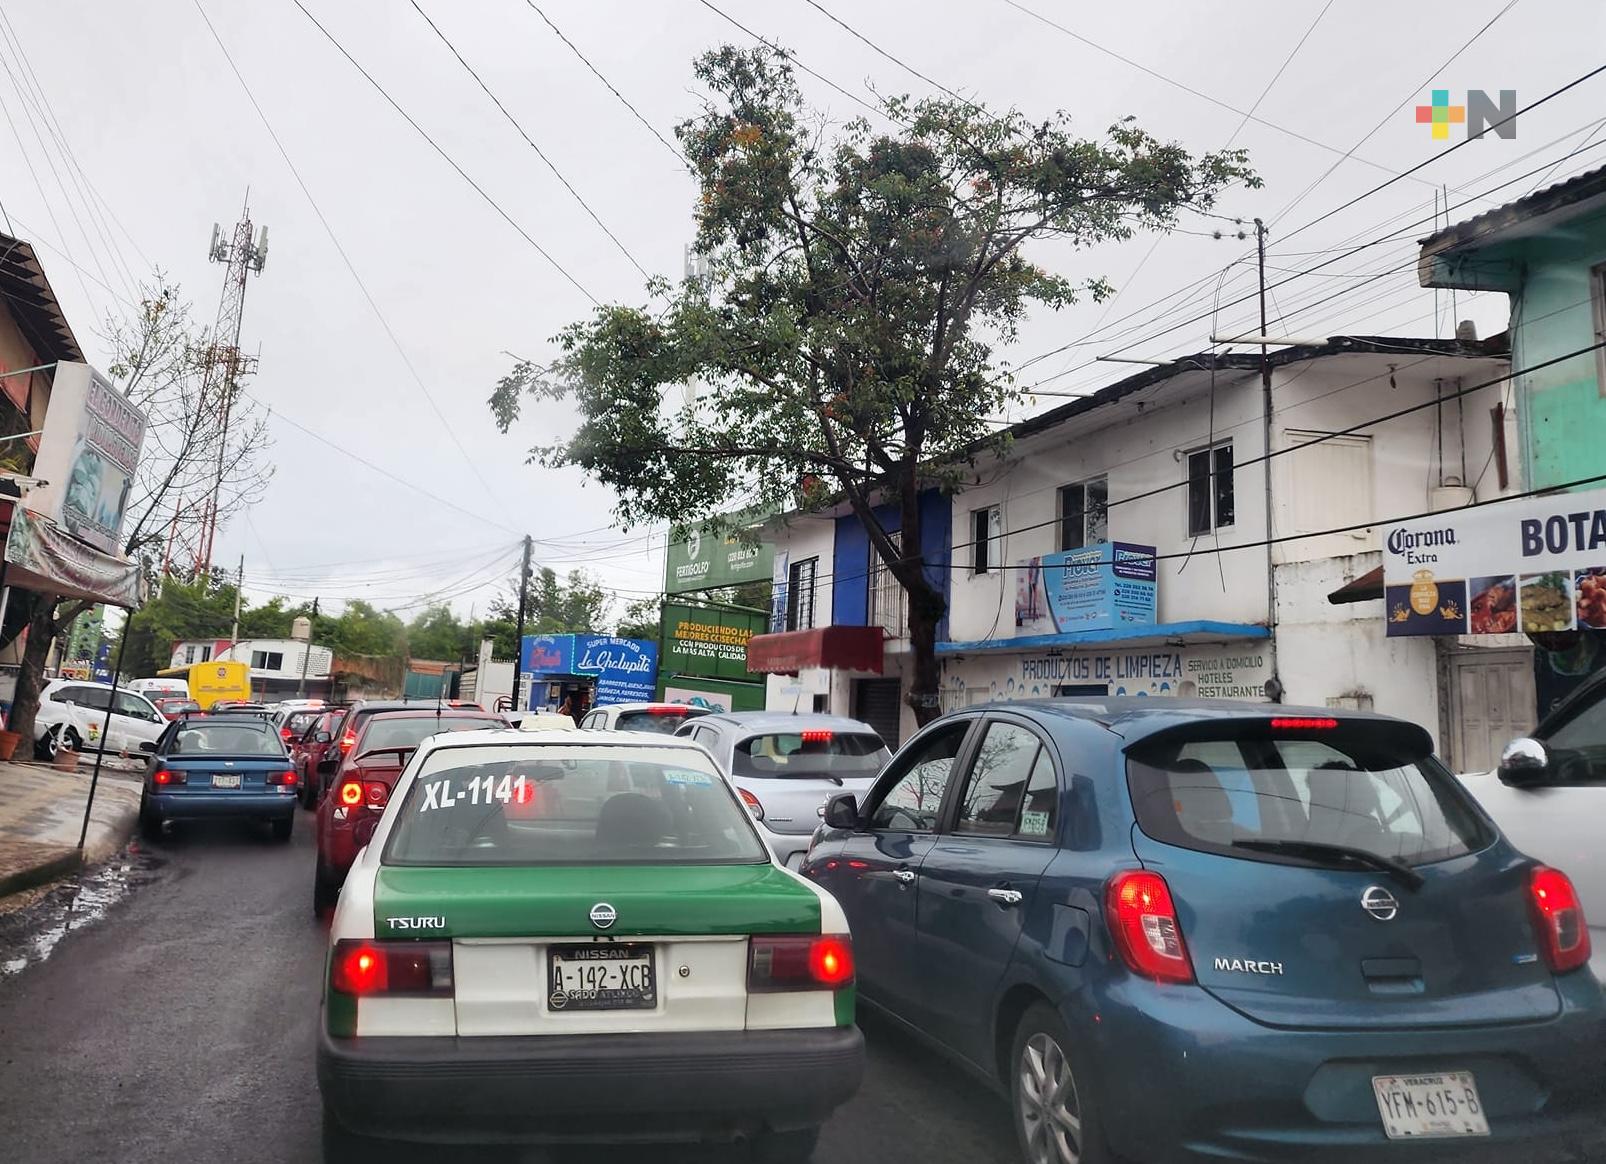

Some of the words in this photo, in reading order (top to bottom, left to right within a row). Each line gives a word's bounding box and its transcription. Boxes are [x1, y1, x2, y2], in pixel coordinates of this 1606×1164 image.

[1387, 528, 1457, 556] Corona
[1407, 551, 1438, 565] Extra
[676, 560, 709, 577] FERTIGOLFO
[678, 621, 738, 636] PRODUCIENDO
[586, 638, 608, 648] SUPER
[609, 638, 640, 653] MERCADO
[675, 630, 708, 640] MEJORES
[710, 634, 751, 645] COSECHA
[672, 645, 682, 654] LA
[697, 648, 716, 657] ALTA
[718, 651, 747, 661] CALIDAD
[679, 639, 694, 648] CON
[694, 641, 736, 652] PRODUCTOS
[735, 645, 745, 653] DE
[596, 650, 651, 674] Chalupita
[1022, 656, 1089, 680] PRODUCTOS
[1095, 656, 1111, 679] DE
[1117, 654, 1183, 679] LIMPIEZA
[1188, 660, 1218, 672] SERVICIO
[1219, 659, 1225, 670] A
[1226, 656, 1263, 669] DOMICILIO
[1198, 673, 1233, 684] HOTELES
[420, 774, 526, 812] XL-1141
[387, 916, 445, 929] TSURU
[575, 950, 629, 959] NISSAN
[1214, 957, 1285, 975] MARCH
[554, 964, 651, 991] A-142-XCB
[1402, 1078, 1444, 1087] VERACRUZ
[1381, 1088, 1479, 1119] YFM-615-B
